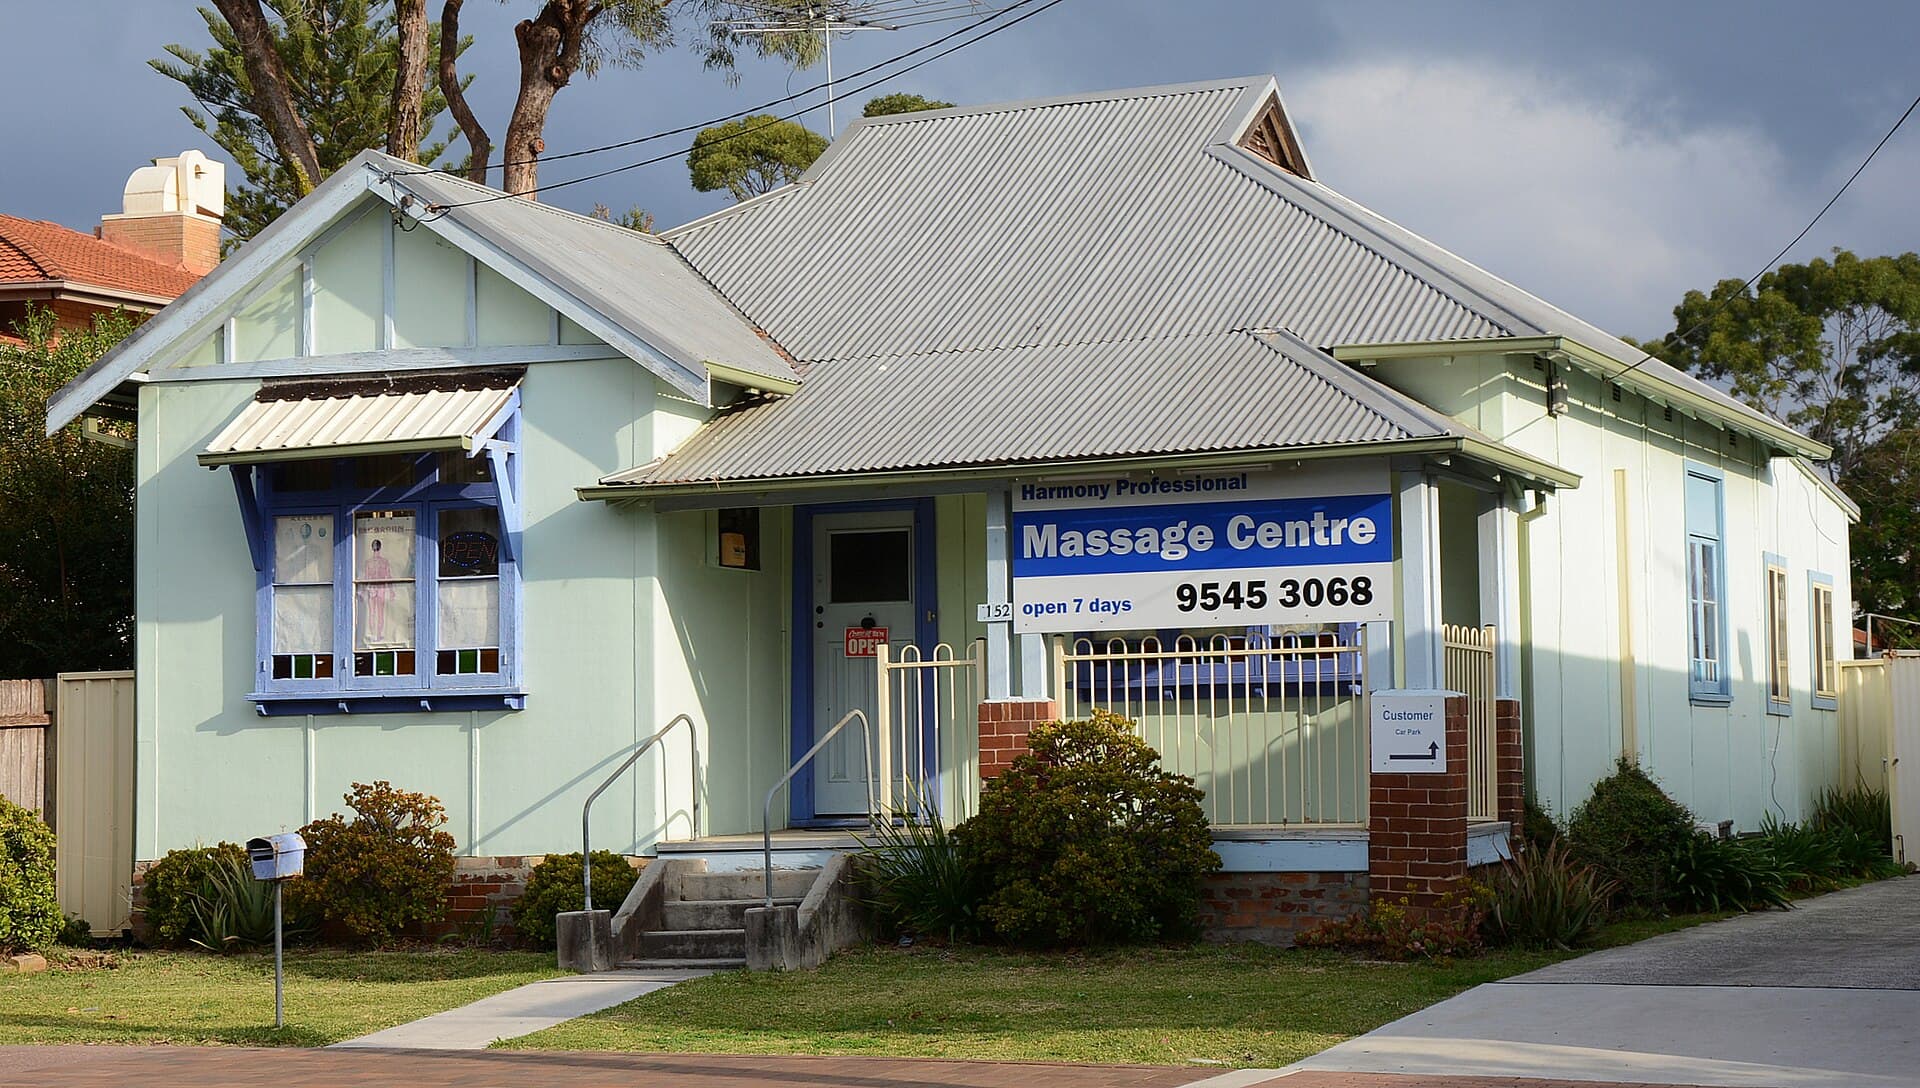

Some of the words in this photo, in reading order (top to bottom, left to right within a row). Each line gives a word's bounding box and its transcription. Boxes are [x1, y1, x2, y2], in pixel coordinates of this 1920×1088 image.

[1021, 484, 1110, 500] Harmony
[1116, 473, 1247, 496] Professional
[1022, 520, 1214, 561] Massage
[1226, 512, 1376, 550] Centre
[1176, 580, 1267, 613] 9545
[1279, 576, 1373, 608] 3068
[986, 604, 1010, 618] 152
[1022, 602, 1067, 617] open
[1073, 599, 1082, 614] 7
[1089, 598, 1132, 615] days
[1383, 710, 1433, 720] Customer
